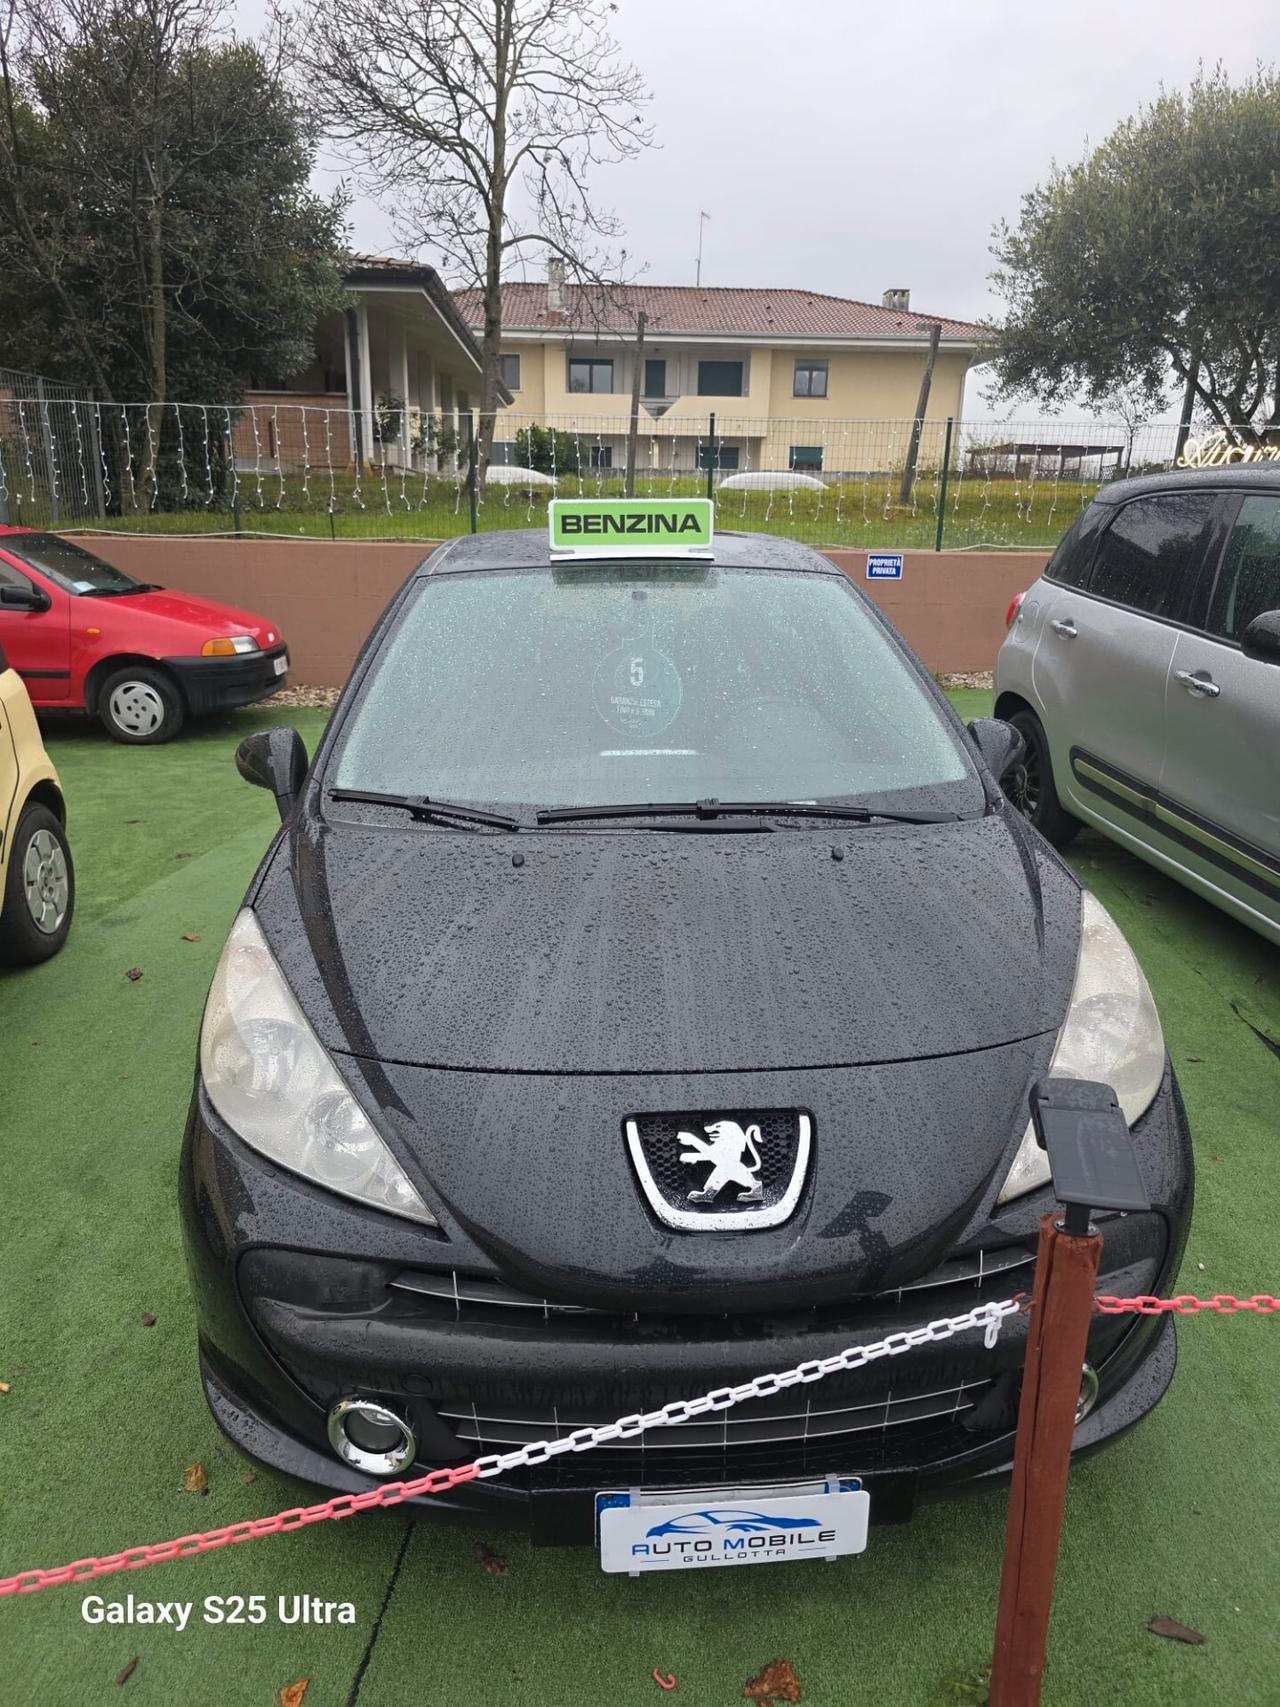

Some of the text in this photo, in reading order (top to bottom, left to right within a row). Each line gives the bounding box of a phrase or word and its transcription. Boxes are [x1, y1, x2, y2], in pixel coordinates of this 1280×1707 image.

[561, 513, 702, 534] BENZINA
[869, 557, 901, 567] PROPRIETÀ
[872, 567, 897, 575] PRIVATA
[630, 657, 644, 687] 5
[632, 1530, 836, 1556] AUTO MOBILE
[683, 1549, 786, 1563] GULLOTTA
